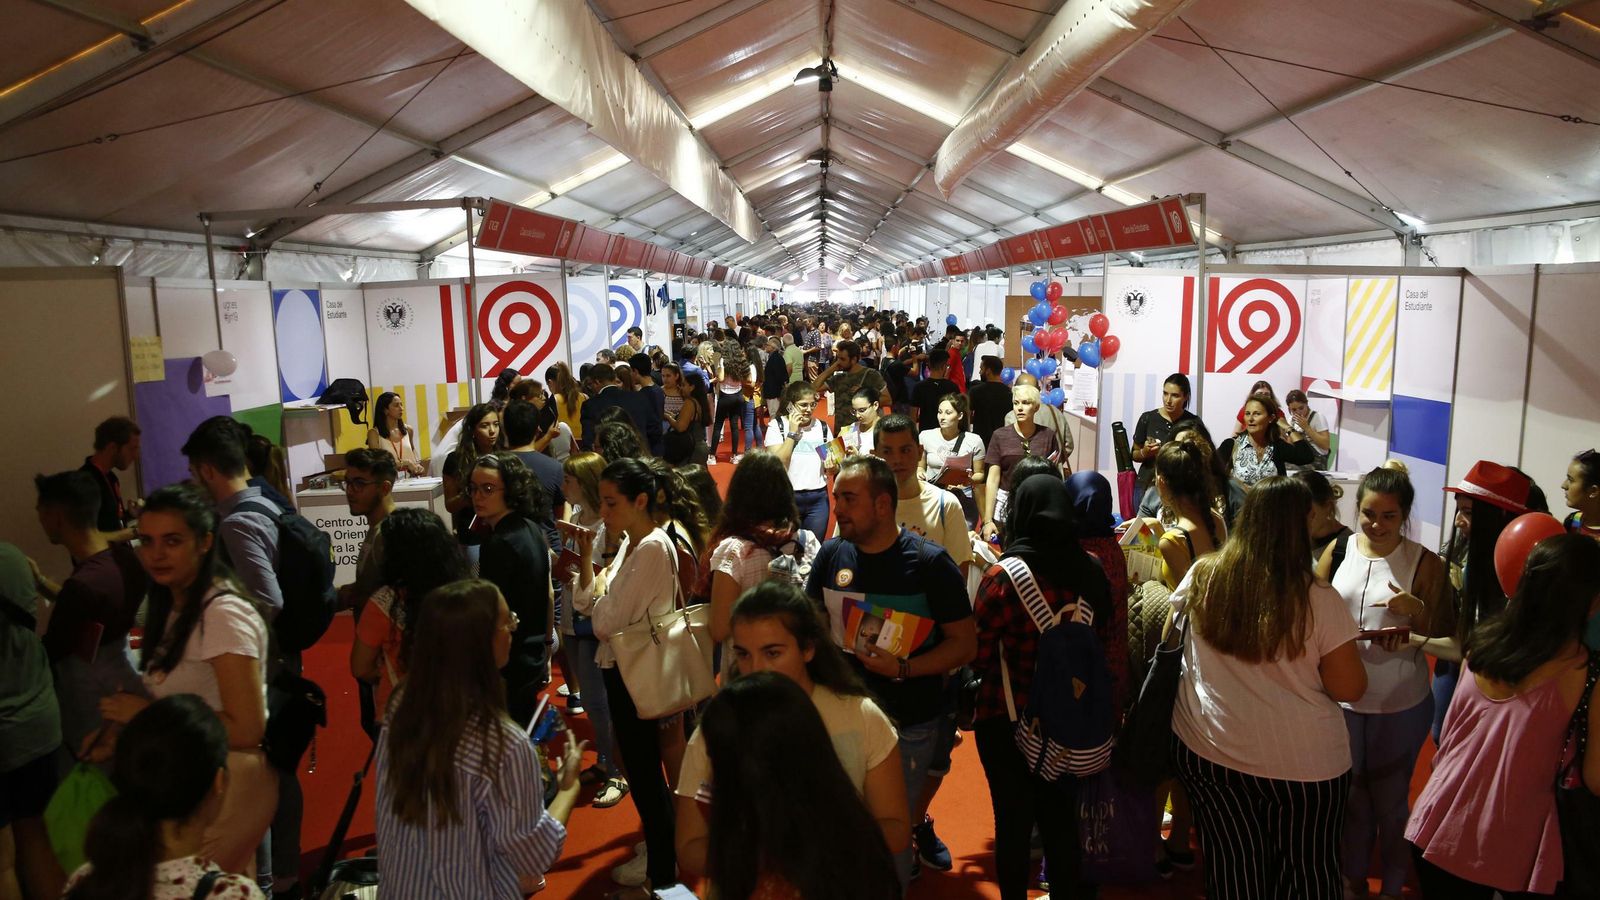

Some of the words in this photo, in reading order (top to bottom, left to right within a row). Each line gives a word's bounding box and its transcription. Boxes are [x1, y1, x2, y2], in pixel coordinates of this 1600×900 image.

[1405, 289, 1419, 299] Casa
[1420, 289, 1428, 299] del
[326, 300, 337, 309] Casa
[1404, 301, 1433, 311] Estudiante
[327, 310, 348, 319] Estudiante
[316, 517, 353, 528] Centro
[356, 516, 369, 527] Ju
[334, 529, 368, 540] Orient
[332, 544, 343, 553] ra
[345, 542, 355, 552] la
